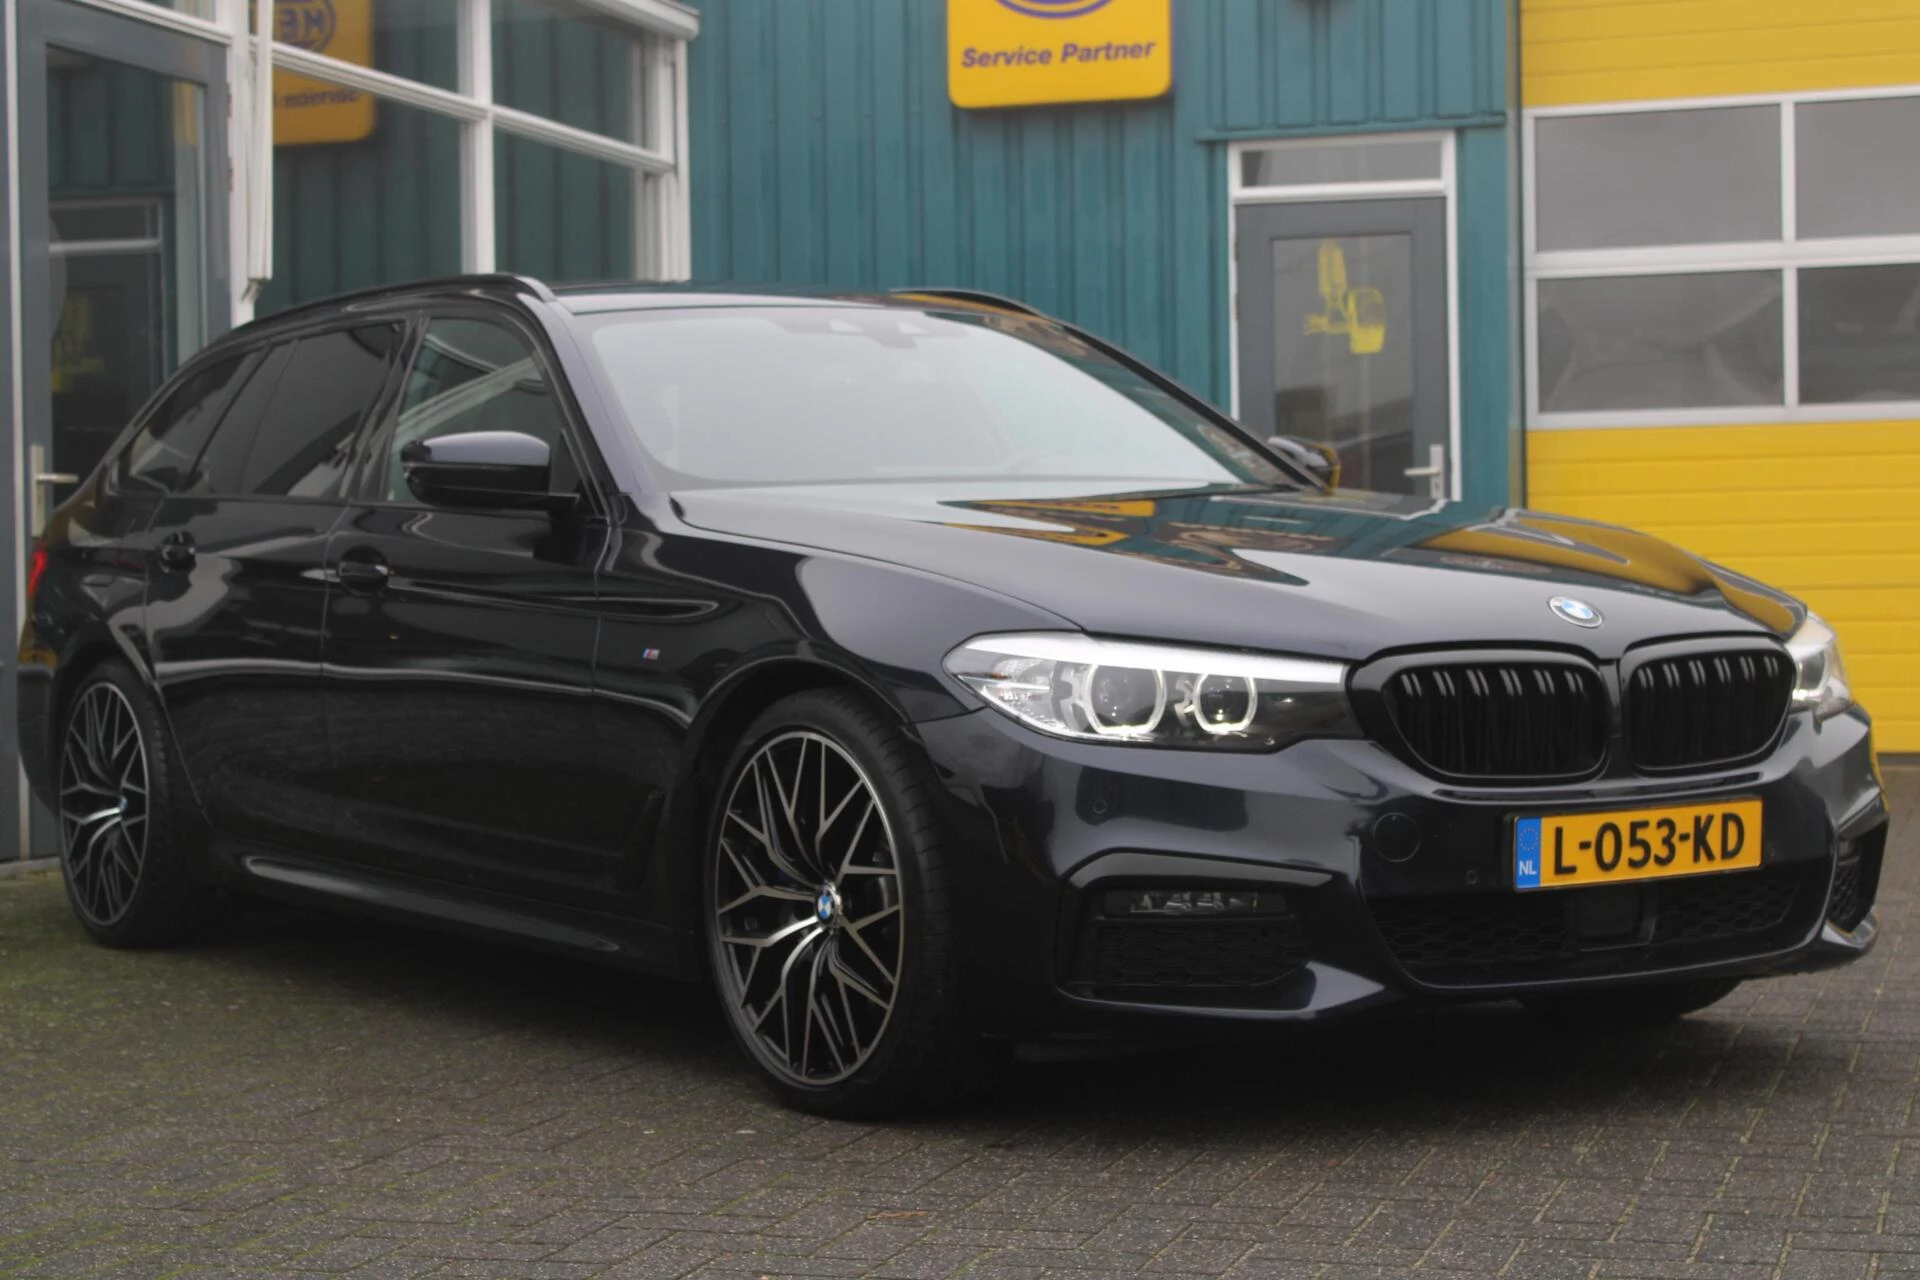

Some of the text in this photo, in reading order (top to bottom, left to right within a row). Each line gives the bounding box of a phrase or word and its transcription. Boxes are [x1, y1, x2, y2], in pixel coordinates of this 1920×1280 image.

[961, 40, 1156, 68] Service Partner
[1554, 812, 1745, 876] L-053-KD
[1518, 859, 1537, 876] NL
